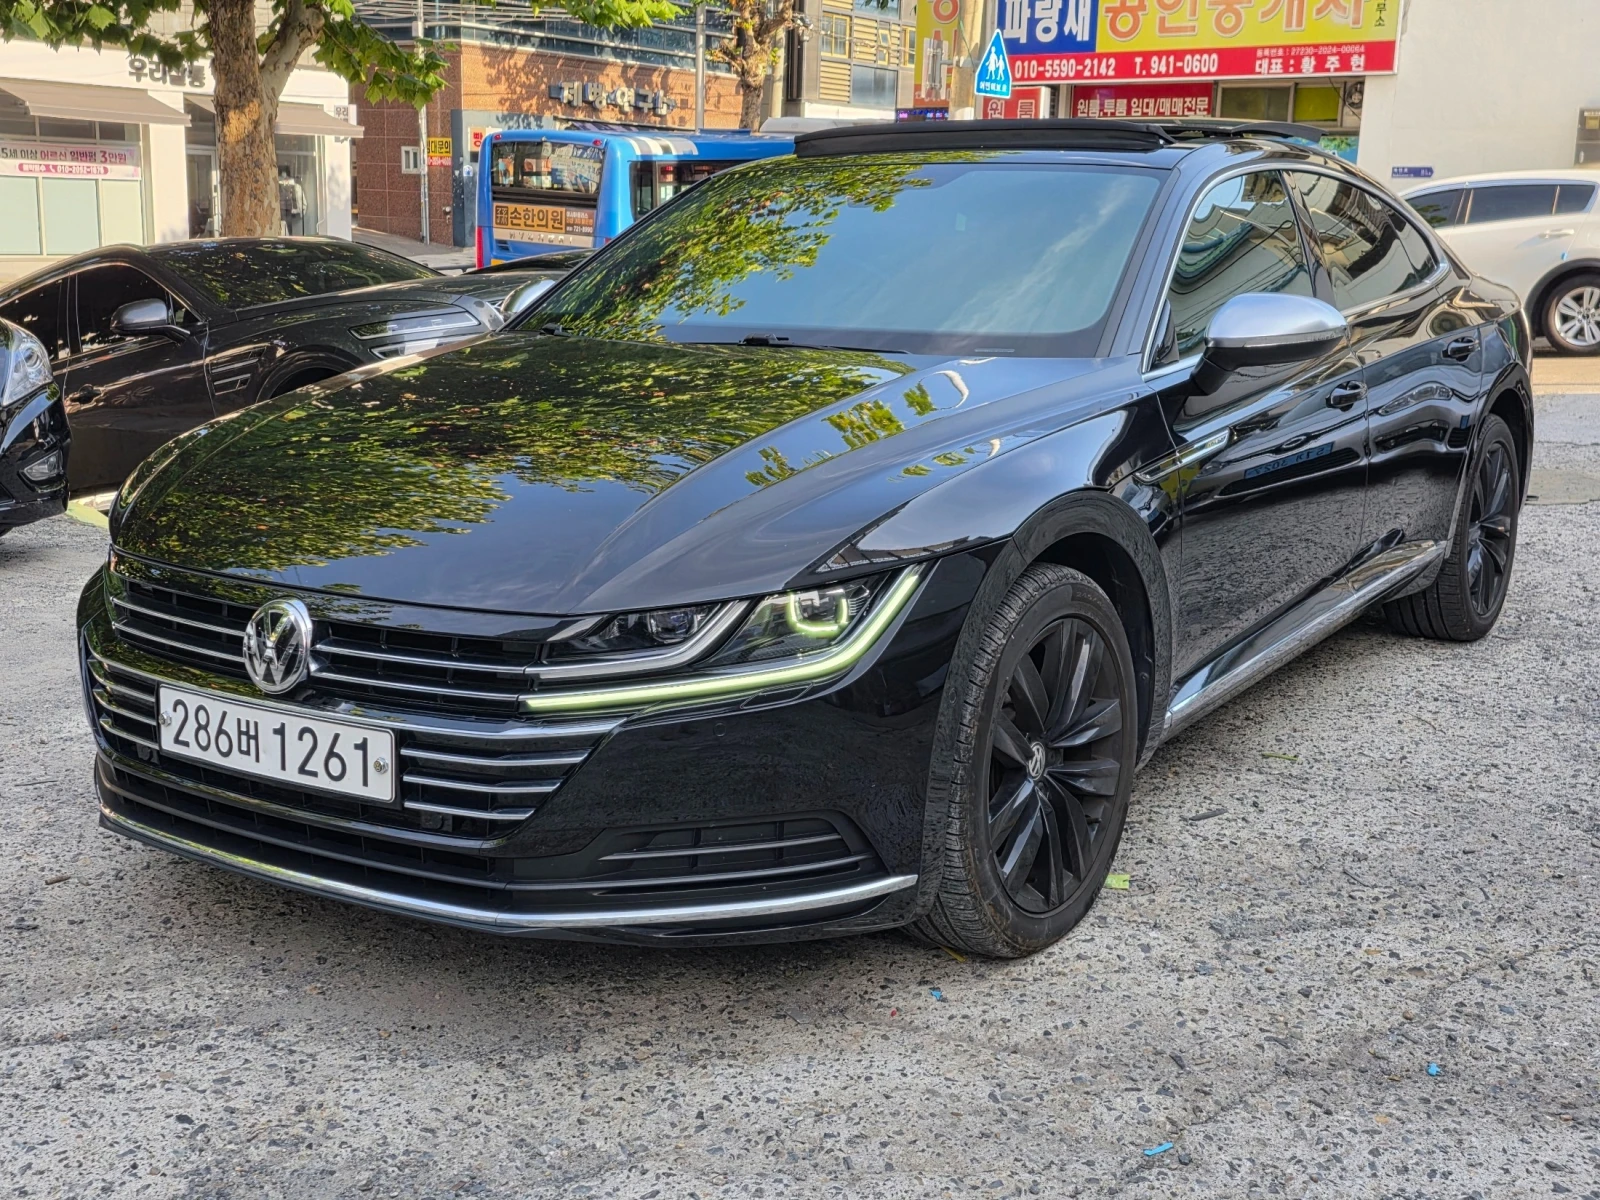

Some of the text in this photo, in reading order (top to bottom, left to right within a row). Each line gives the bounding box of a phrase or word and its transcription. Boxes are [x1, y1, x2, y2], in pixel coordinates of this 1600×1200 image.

[1003, 0, 1091, 43] 파랑새
[1374, 0, 1387, 27] 무소
[1014, 57, 1116, 79] 010-5590-2142
[1130, 97, 1209, 116] 임대/매매전문
[509, 207, 564, 231] 손한의원
[272, 722, 369, 787] 1261
